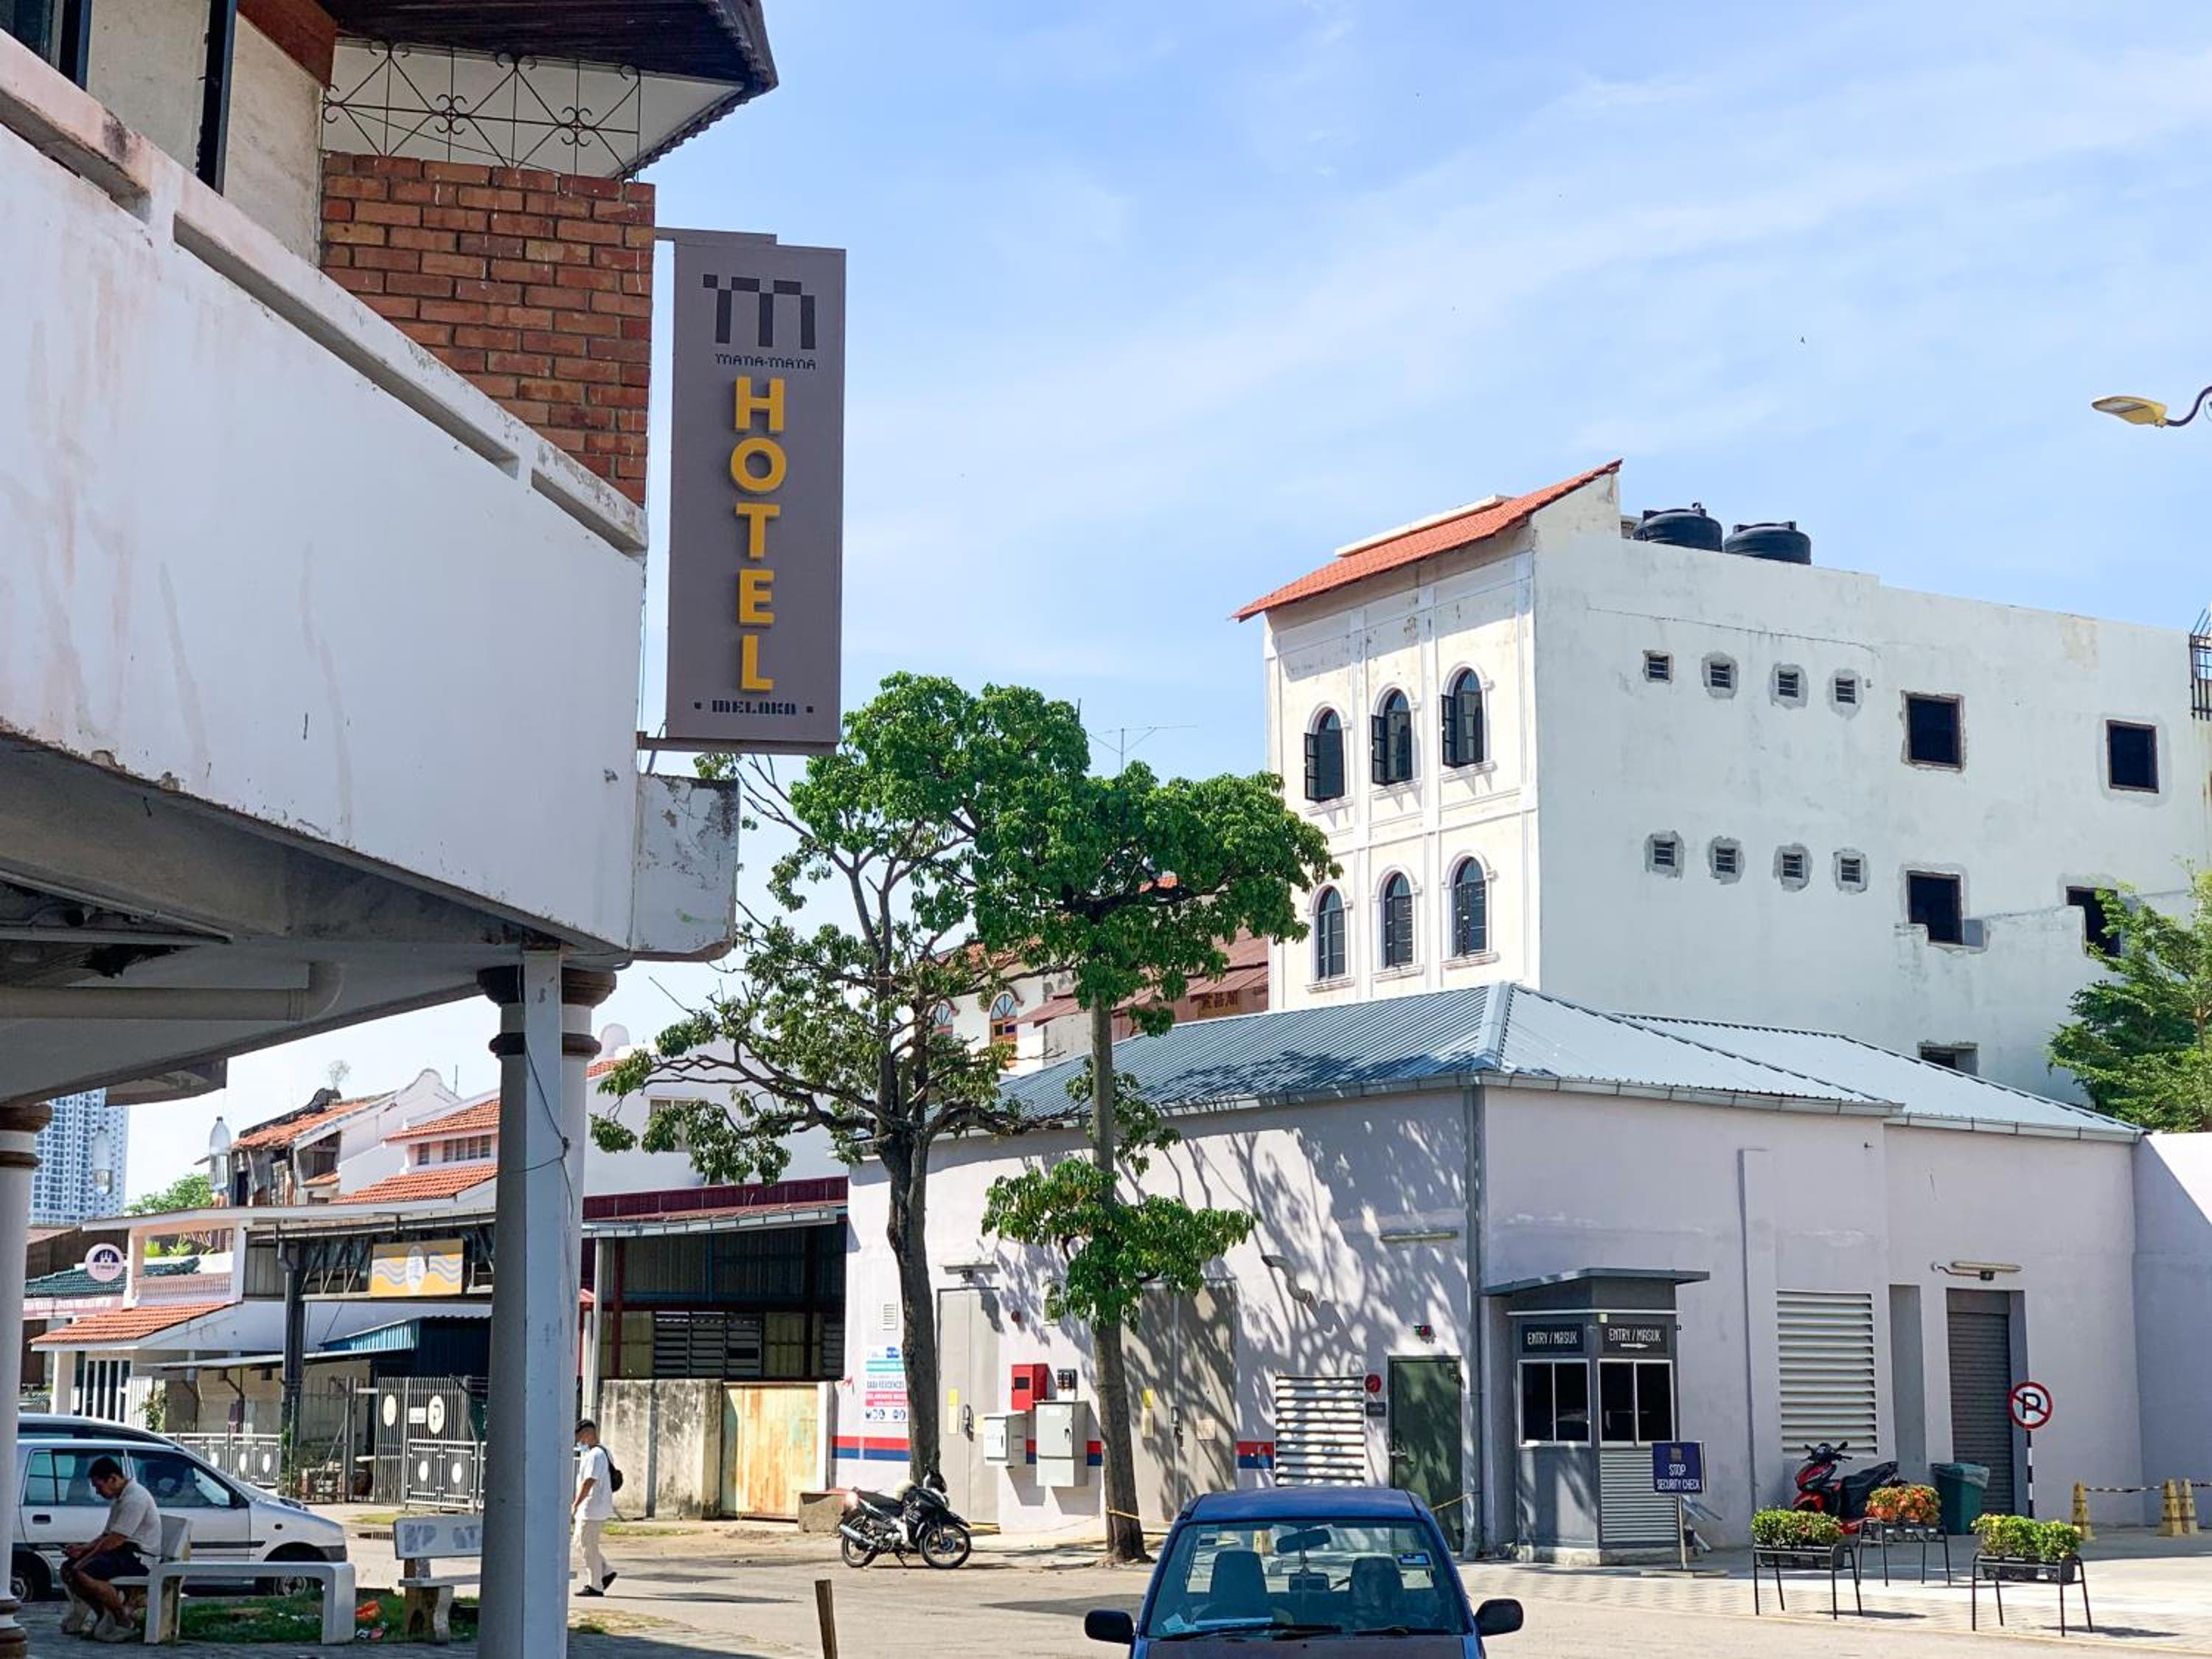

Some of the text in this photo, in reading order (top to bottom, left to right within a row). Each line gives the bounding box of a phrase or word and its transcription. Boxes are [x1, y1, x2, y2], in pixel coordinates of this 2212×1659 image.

[731, 376, 787, 694] HOTEL
[712, 700, 797, 715] MELAKA
[1527, 1332, 1548, 1345] ENTRY
[1554, 1330, 1577, 1345] MASUK
[1608, 1328, 1630, 1341] ENTRY
[1637, 1329, 1661, 1342] MASUK
[1669, 1464, 1686, 1476] STOP
[1657, 1478, 1681, 1490] SECURITY
